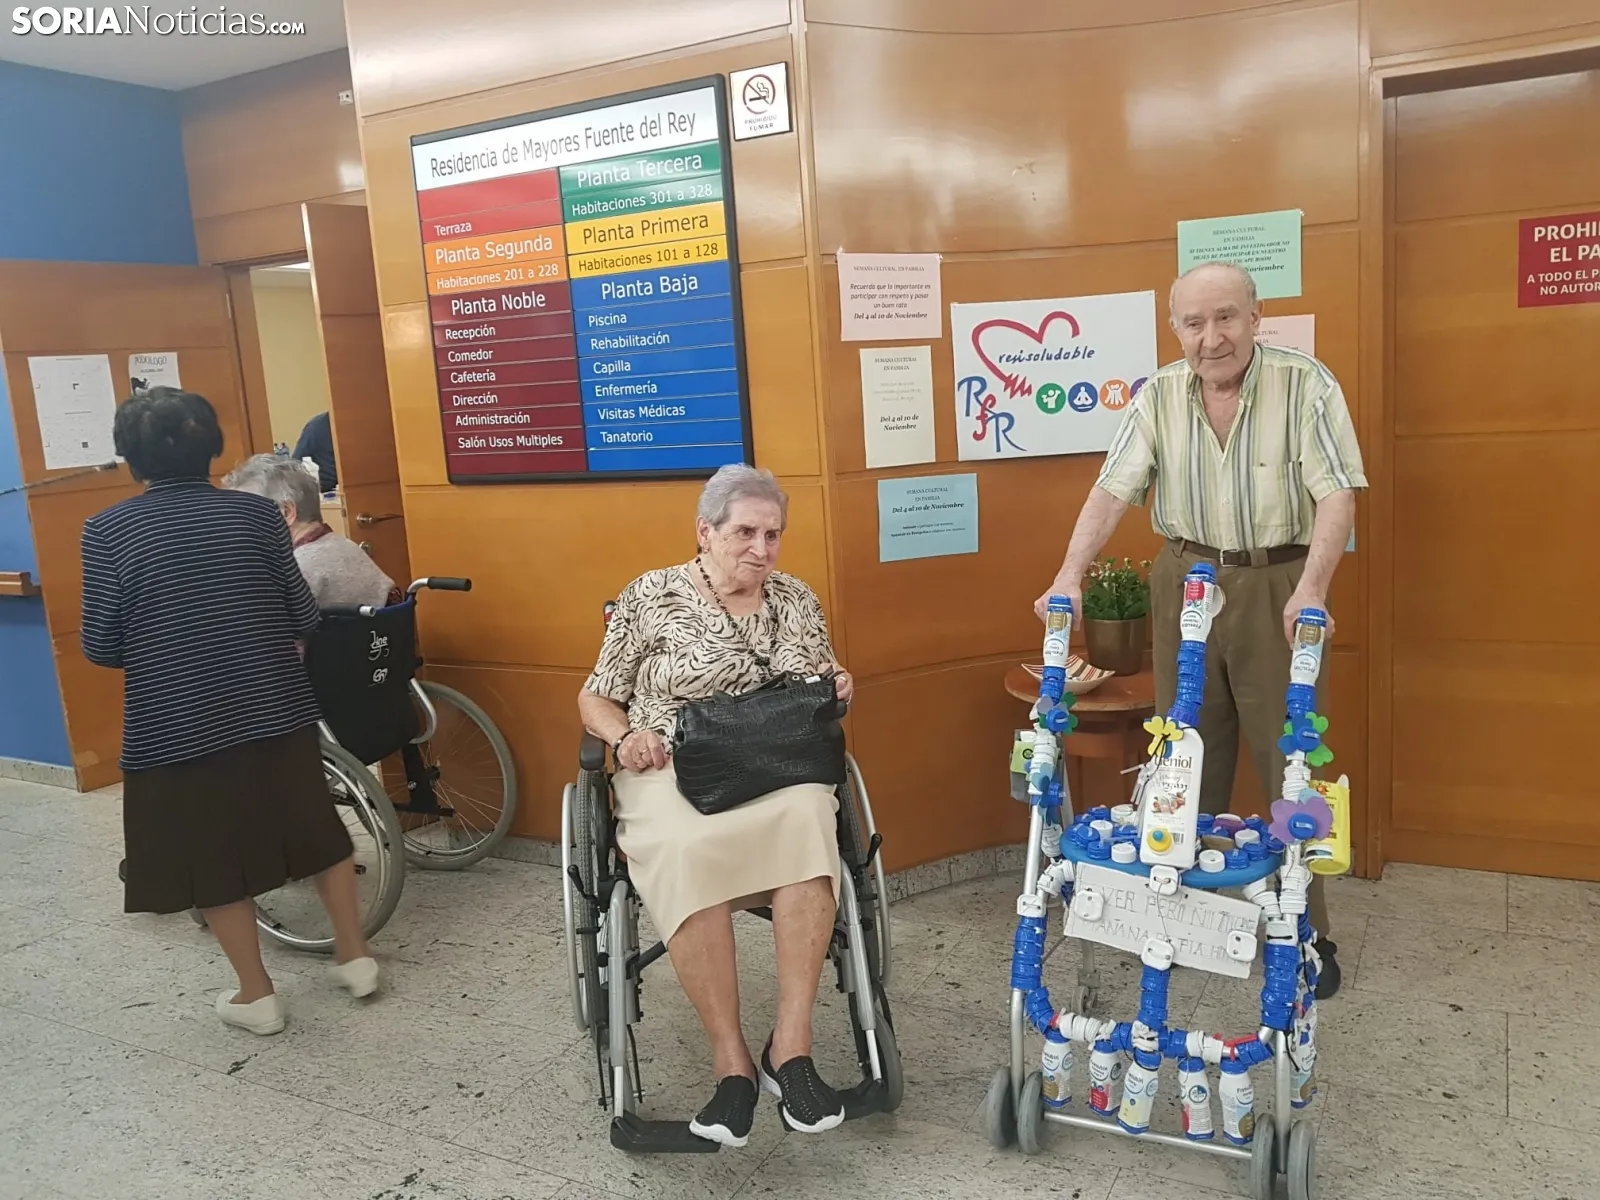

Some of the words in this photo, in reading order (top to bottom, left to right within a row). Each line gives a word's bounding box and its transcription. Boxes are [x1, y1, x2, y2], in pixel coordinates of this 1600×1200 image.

[749, 122, 774, 132] FUMAR
[430, 149, 498, 178] Residencia
[502, 141, 518, 163] de
[523, 134, 580, 164] Mayores
[585, 121, 634, 150] Fuente
[640, 112, 662, 140] del
[668, 110, 697, 139] Rey
[577, 164, 631, 188] Planta
[636, 153, 702, 179] Tercera
[572, 194, 646, 217] Habitaciones
[650, 191, 673, 205] 301
[677, 191, 685, 201] a
[689, 184, 713, 199] 328
[434, 220, 472, 237] Terraza
[583, 220, 635, 245] Planta
[641, 211, 709, 237] Primera
[1534, 221, 1600, 242] PROHI
[435, 244, 480, 265] Planta
[485, 234, 553, 260] Segunda
[579, 247, 652, 272] Habitaciones
[657, 246, 679, 262] 101
[683, 249, 691, 259] a
[696, 242, 718, 257] 128
[1550, 246, 1572, 263] EL
[436, 273, 501, 290] Habitaciones
[504, 268, 524, 282] 201
[528, 269, 535, 279] a
[537, 263, 559, 277] 228
[1527, 274, 1536, 284] A
[1538, 271, 1572, 283] TODO
[1575, 270, 1588, 280] EL
[601, 280, 653, 300] Planta
[660, 274, 698, 295] Baja
[894, 283, 924, 291] importante
[1540, 285, 1558, 296] NO
[451, 296, 497, 316] Planta
[502, 291, 546, 312] Noble
[850, 292, 877, 300] participar
[588, 312, 627, 327] Piscina
[854, 312, 865, 320] Del
[445, 324, 496, 341] Recepción
[590, 331, 670, 350] Rehabilitación
[448, 349, 493, 363] Comedor
[450, 368, 496, 384] Cafetería
[593, 360, 631, 376] Capilla
[595, 381, 657, 397] Enfermería
[452, 392, 498, 406] Dirección
[598, 406, 635, 420] Visitas
[639, 402, 686, 418] Médicas
[880, 415, 891, 423] Del
[455, 412, 530, 427] Administración
[883, 423, 917, 431] Noviembre
[458, 435, 486, 449] Salón
[489, 436, 514, 448] Usos
[516, 433, 563, 449] Multiples
[600, 430, 653, 444] Tanatorio
[931, 502, 965, 510] Noviembre
